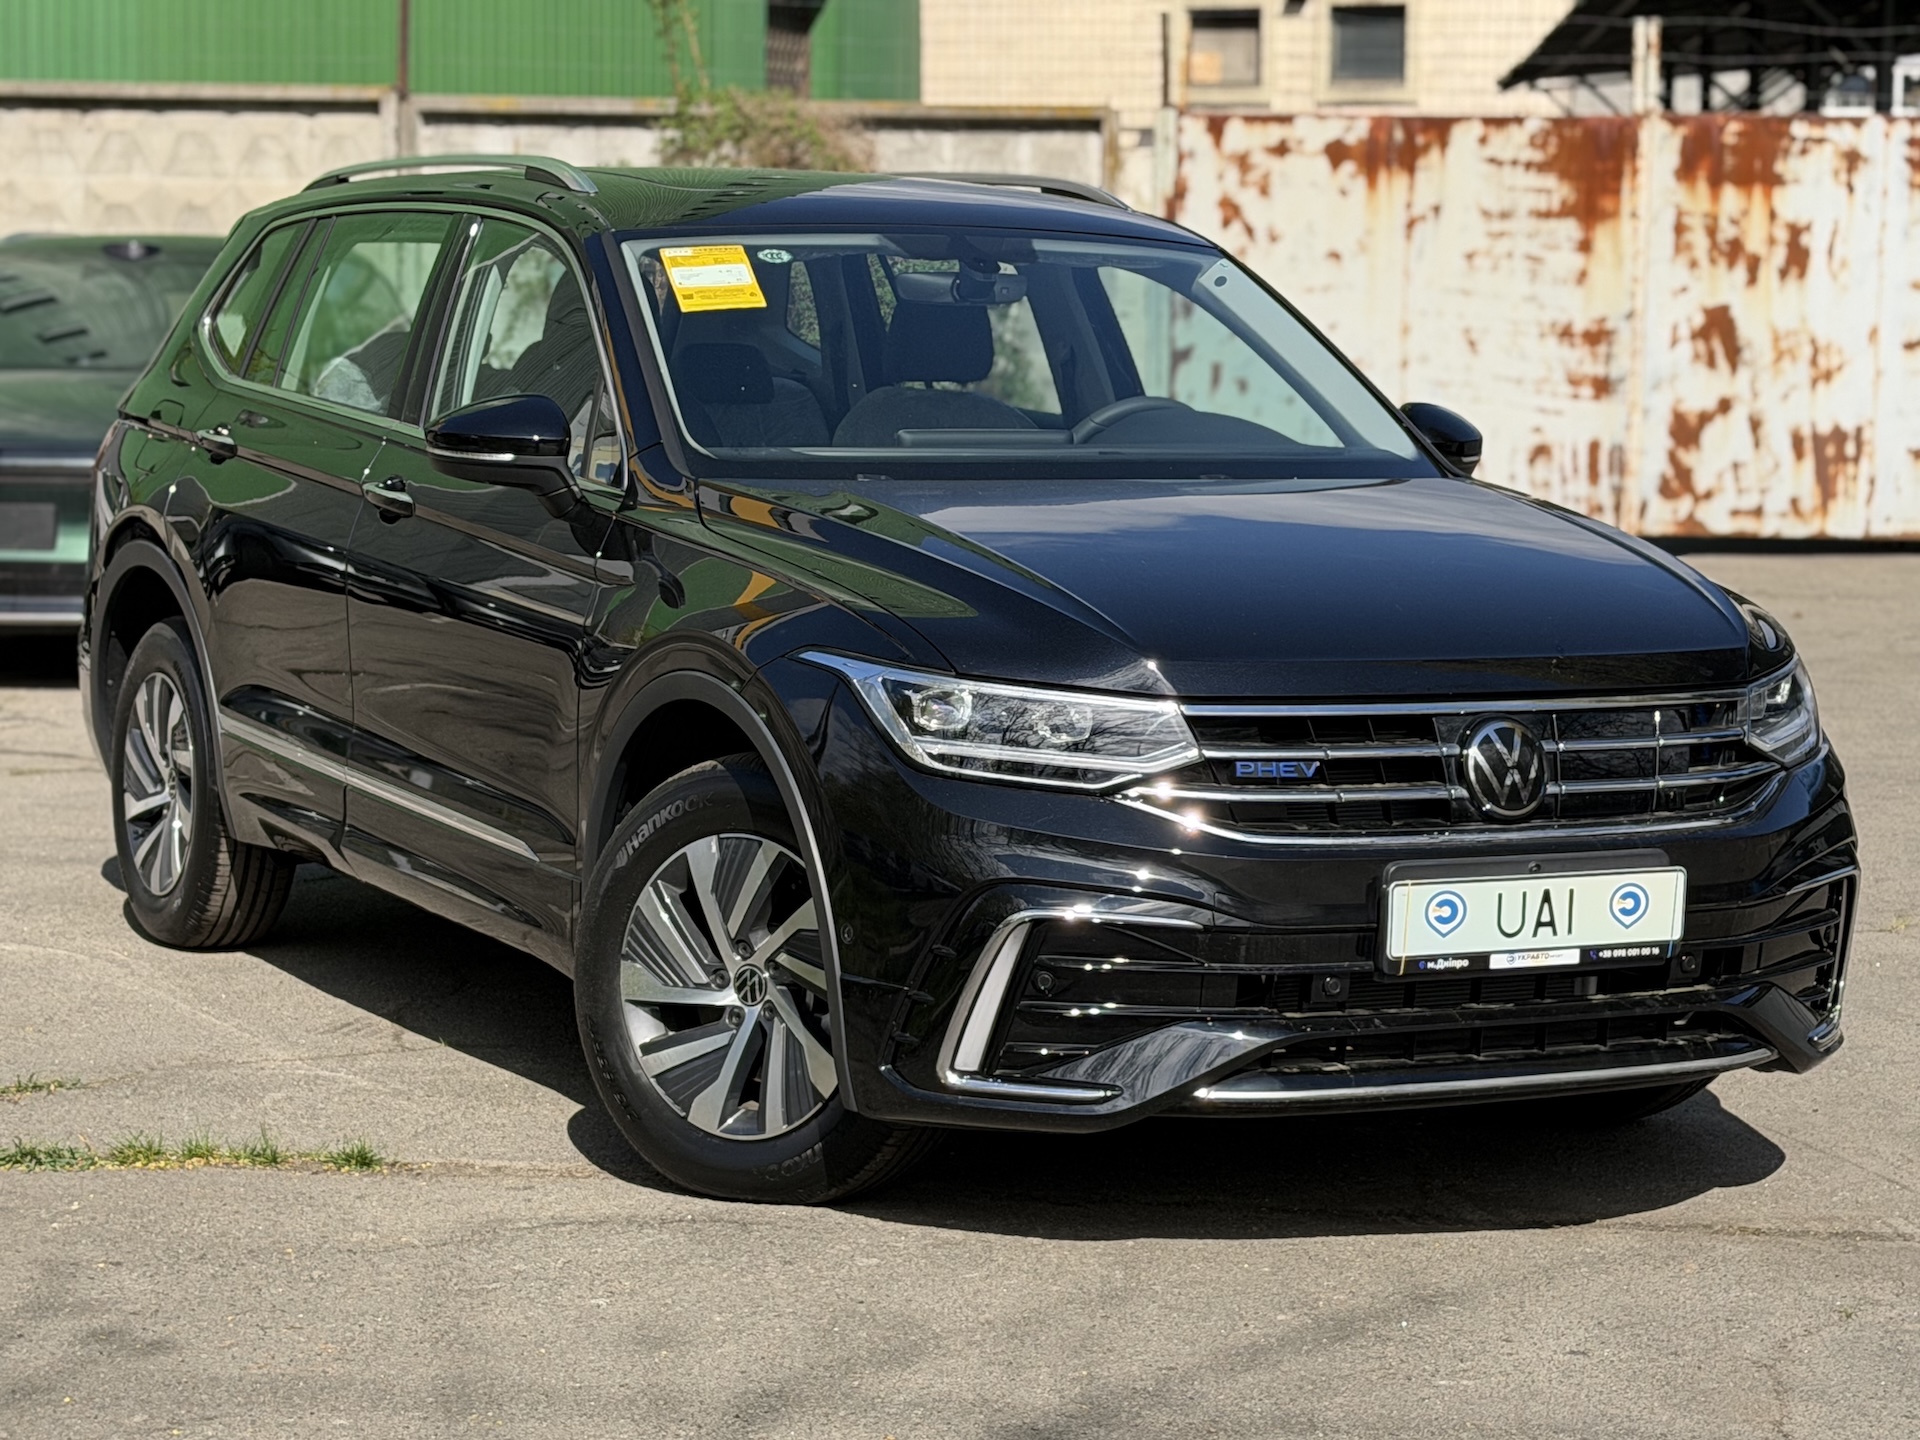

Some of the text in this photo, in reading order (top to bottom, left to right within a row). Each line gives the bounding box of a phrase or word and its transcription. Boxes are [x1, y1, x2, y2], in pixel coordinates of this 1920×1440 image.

[1236, 761, 1320, 778] PHEV
[1466, 721, 1547, 817] VW
[1497, 888, 1574, 938] UAI
